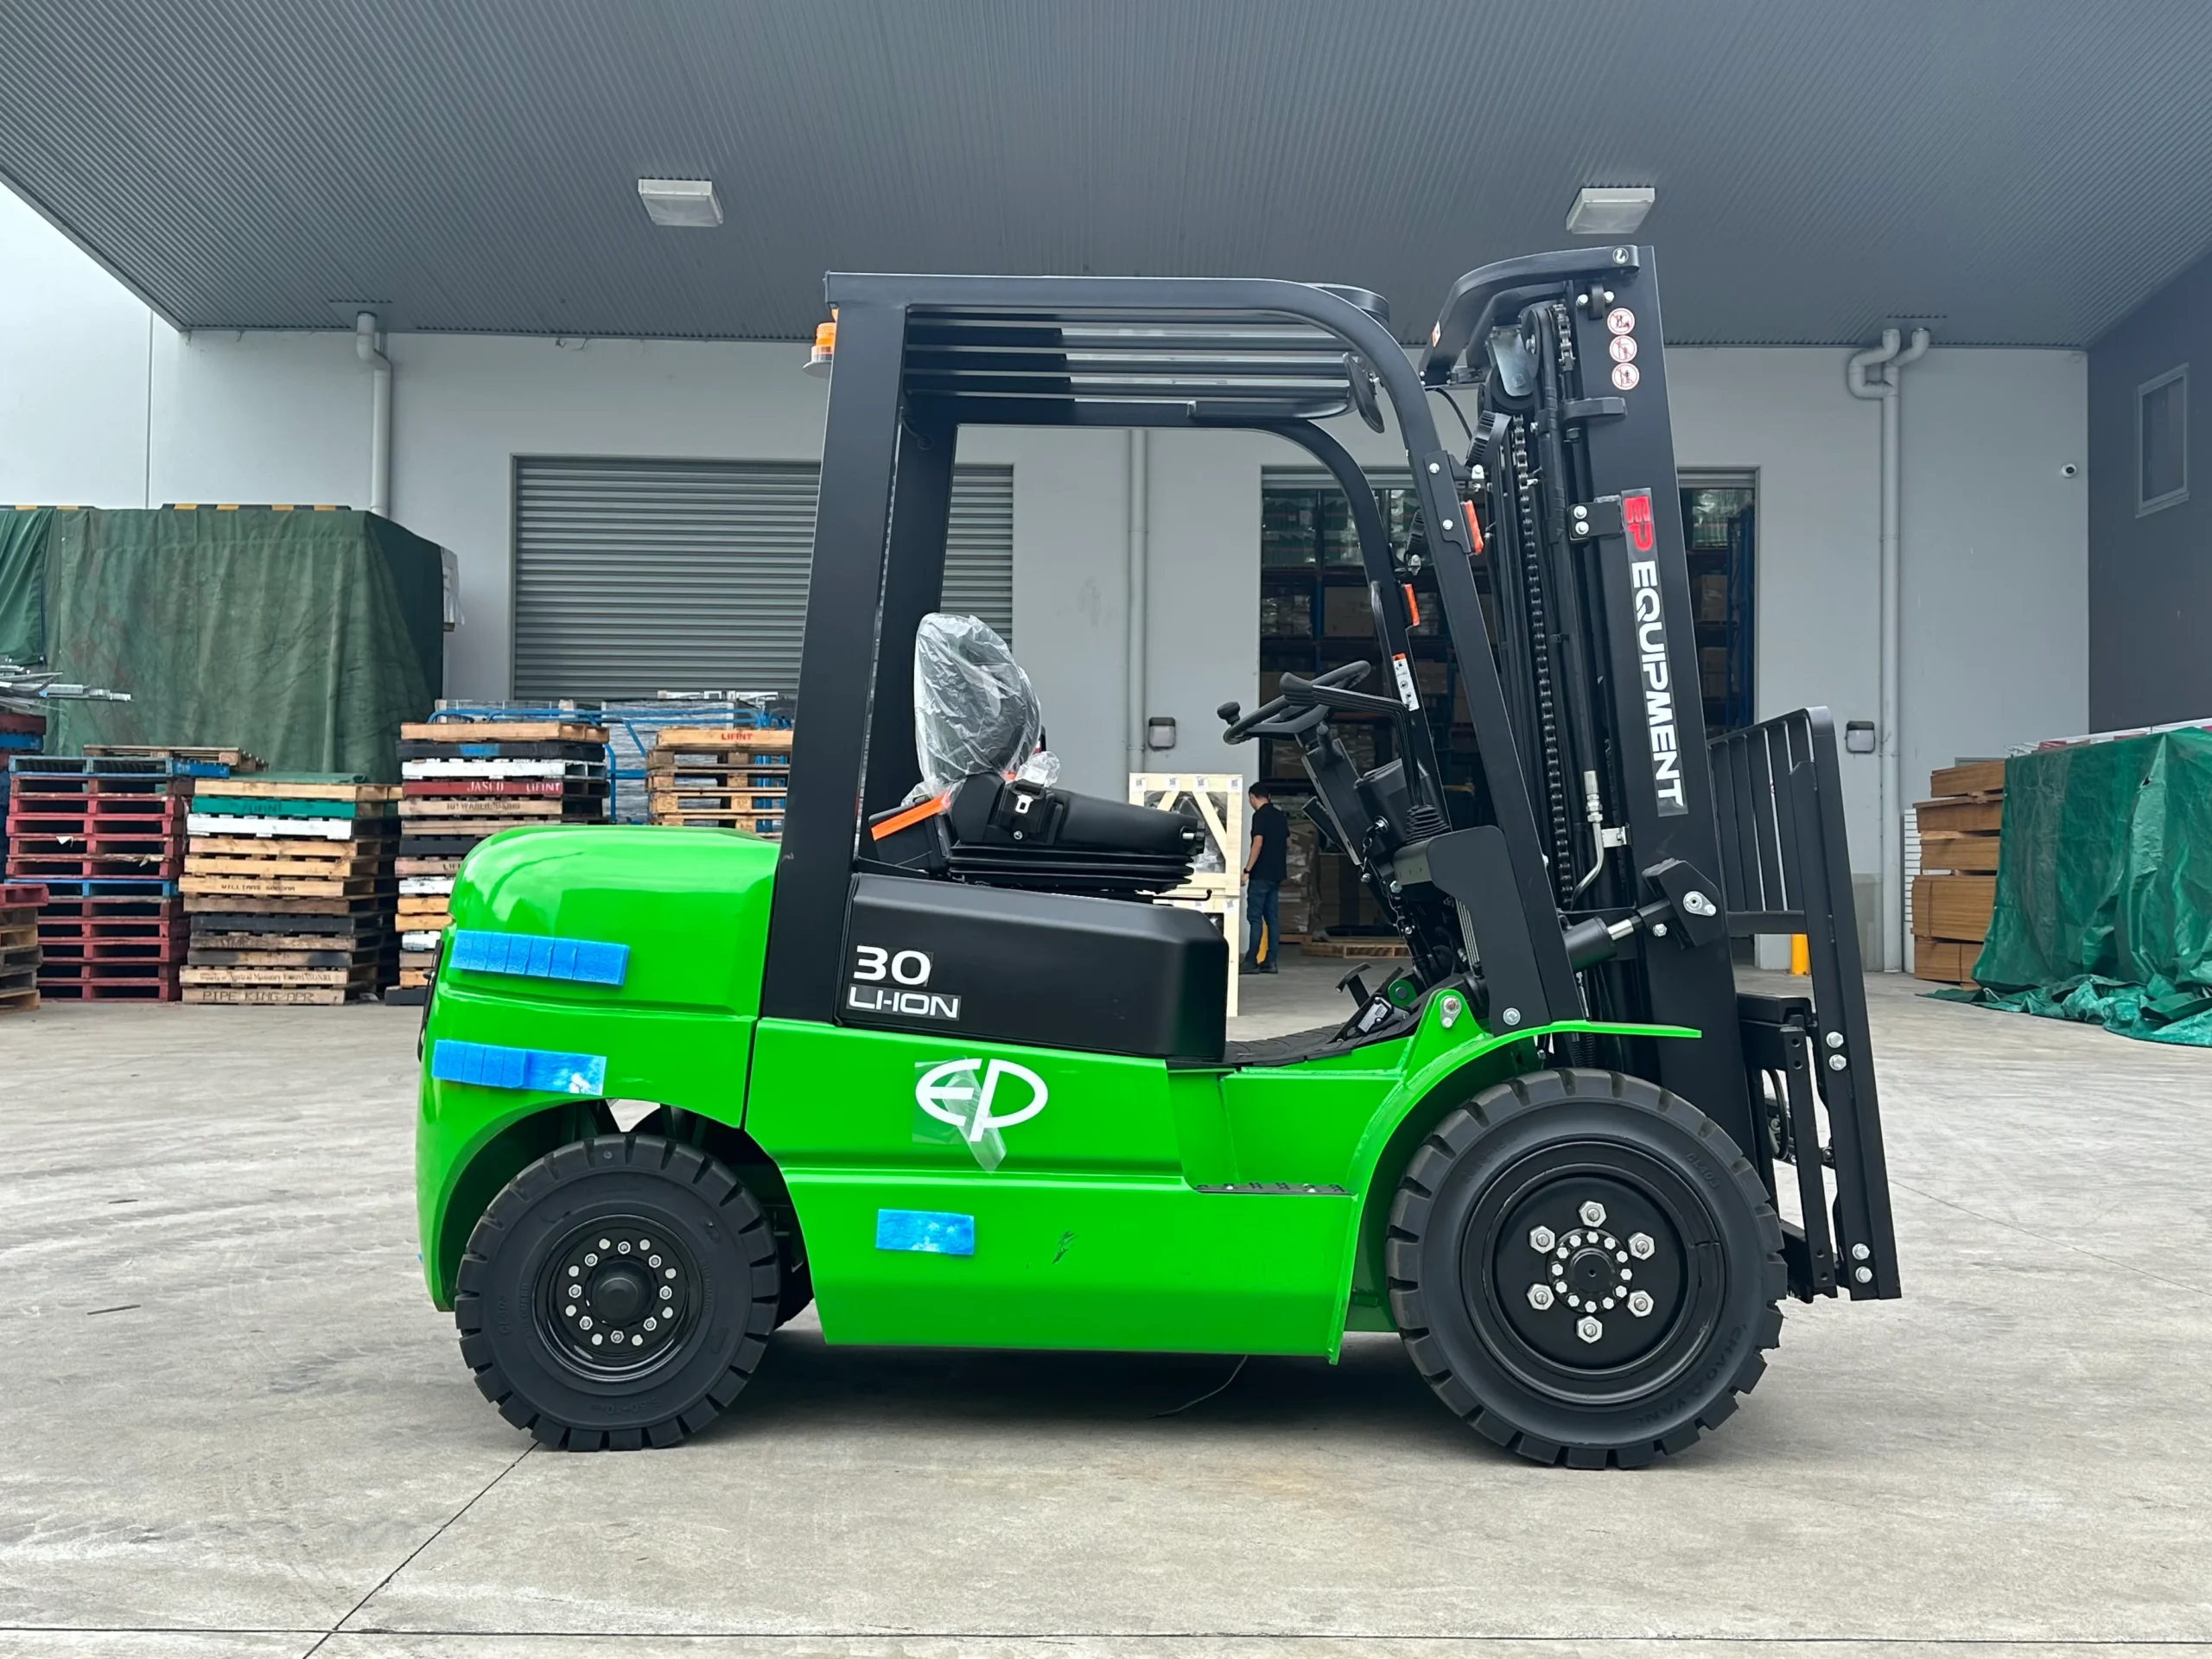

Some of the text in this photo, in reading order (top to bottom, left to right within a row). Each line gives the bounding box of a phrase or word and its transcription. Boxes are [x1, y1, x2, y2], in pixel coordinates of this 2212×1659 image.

[1624, 496, 1684, 808] EP EQUIPMENT
[853, 945, 931, 985] 30
[202, 990, 238, 1001] PIPE
[849, 986, 959, 1019] LI-ION
[915, 1058, 1049, 1142] EP
